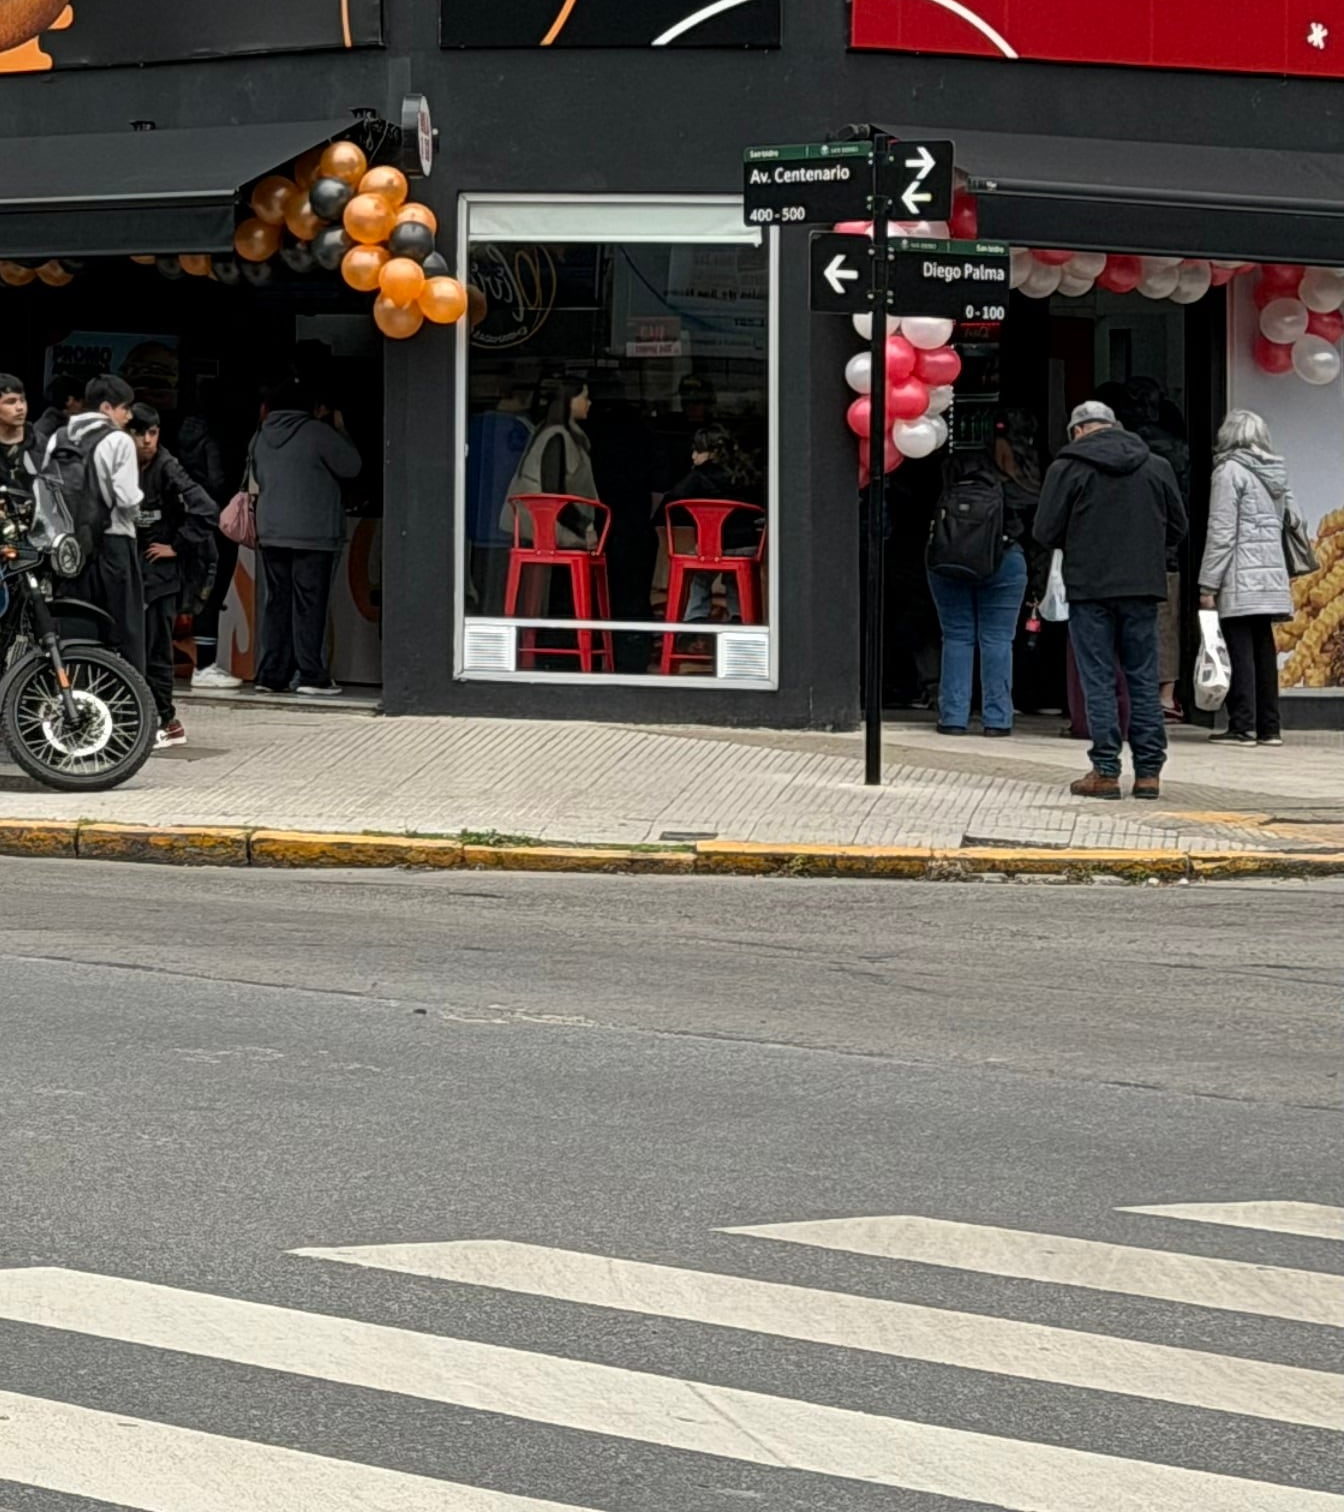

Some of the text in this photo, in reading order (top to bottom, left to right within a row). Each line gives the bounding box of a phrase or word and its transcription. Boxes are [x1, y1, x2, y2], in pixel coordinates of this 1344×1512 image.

[750, 164, 850, 184] Av. Centenario
[923, 261, 1005, 282] Diego Palma
